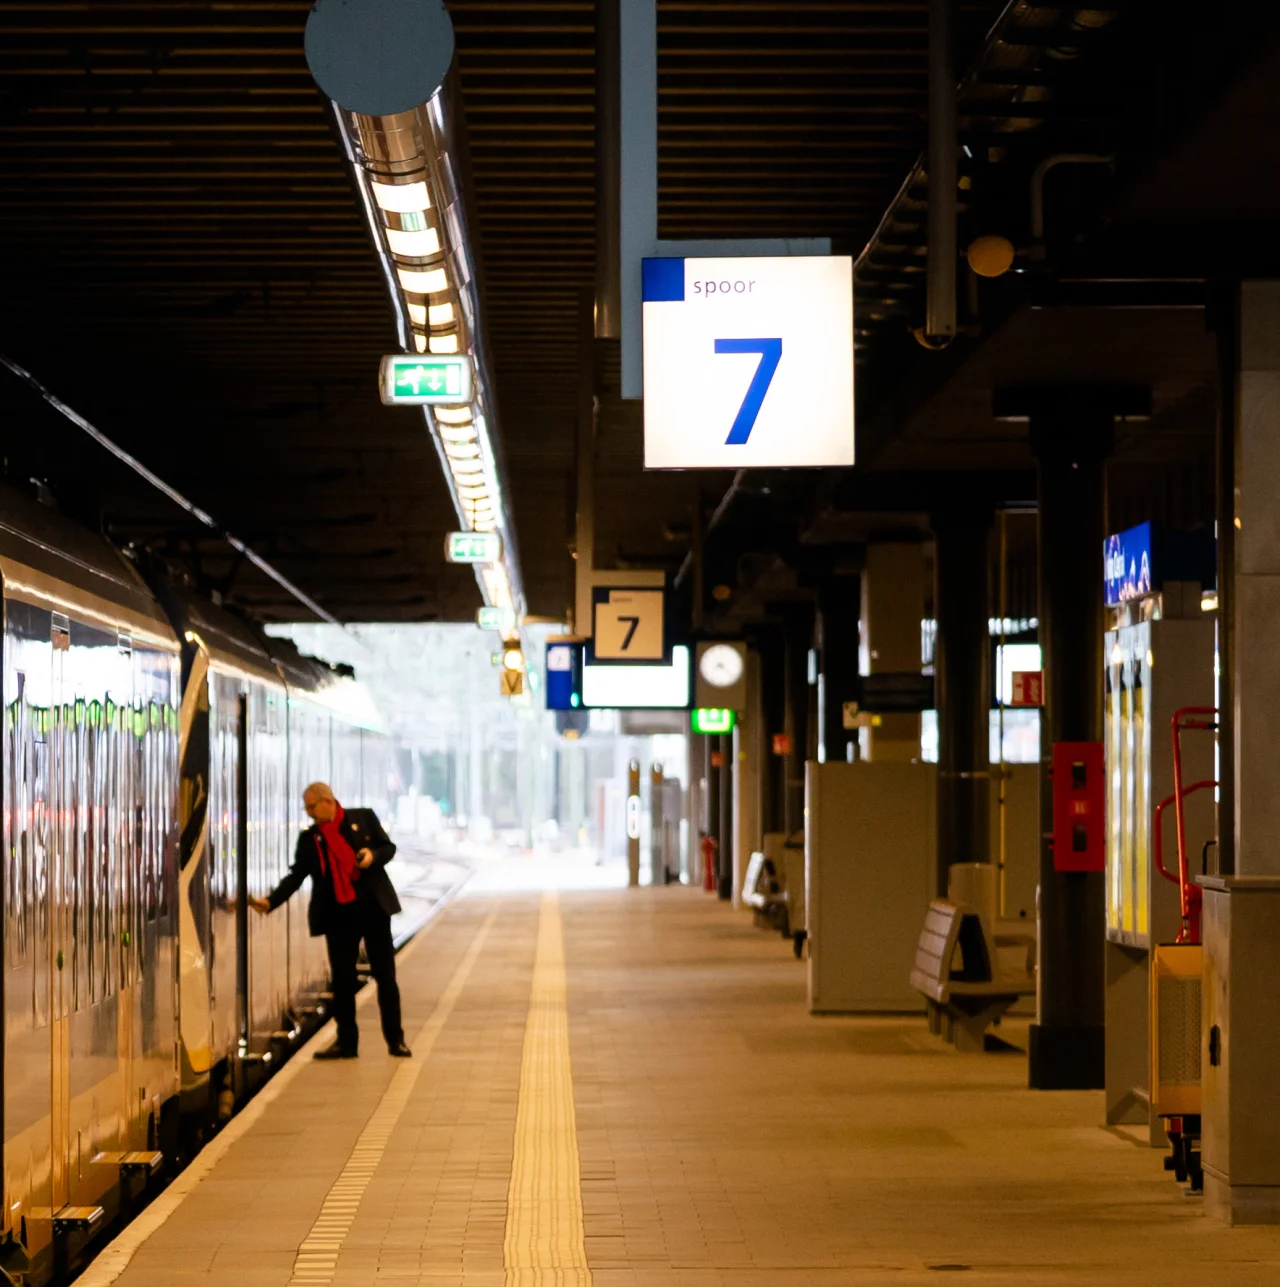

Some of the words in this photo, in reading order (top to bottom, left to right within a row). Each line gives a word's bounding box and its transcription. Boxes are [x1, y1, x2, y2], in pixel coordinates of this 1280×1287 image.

[693, 279, 756, 298] spoor
[714, 338, 782, 444] 7
[617, 616, 640, 651] 7
